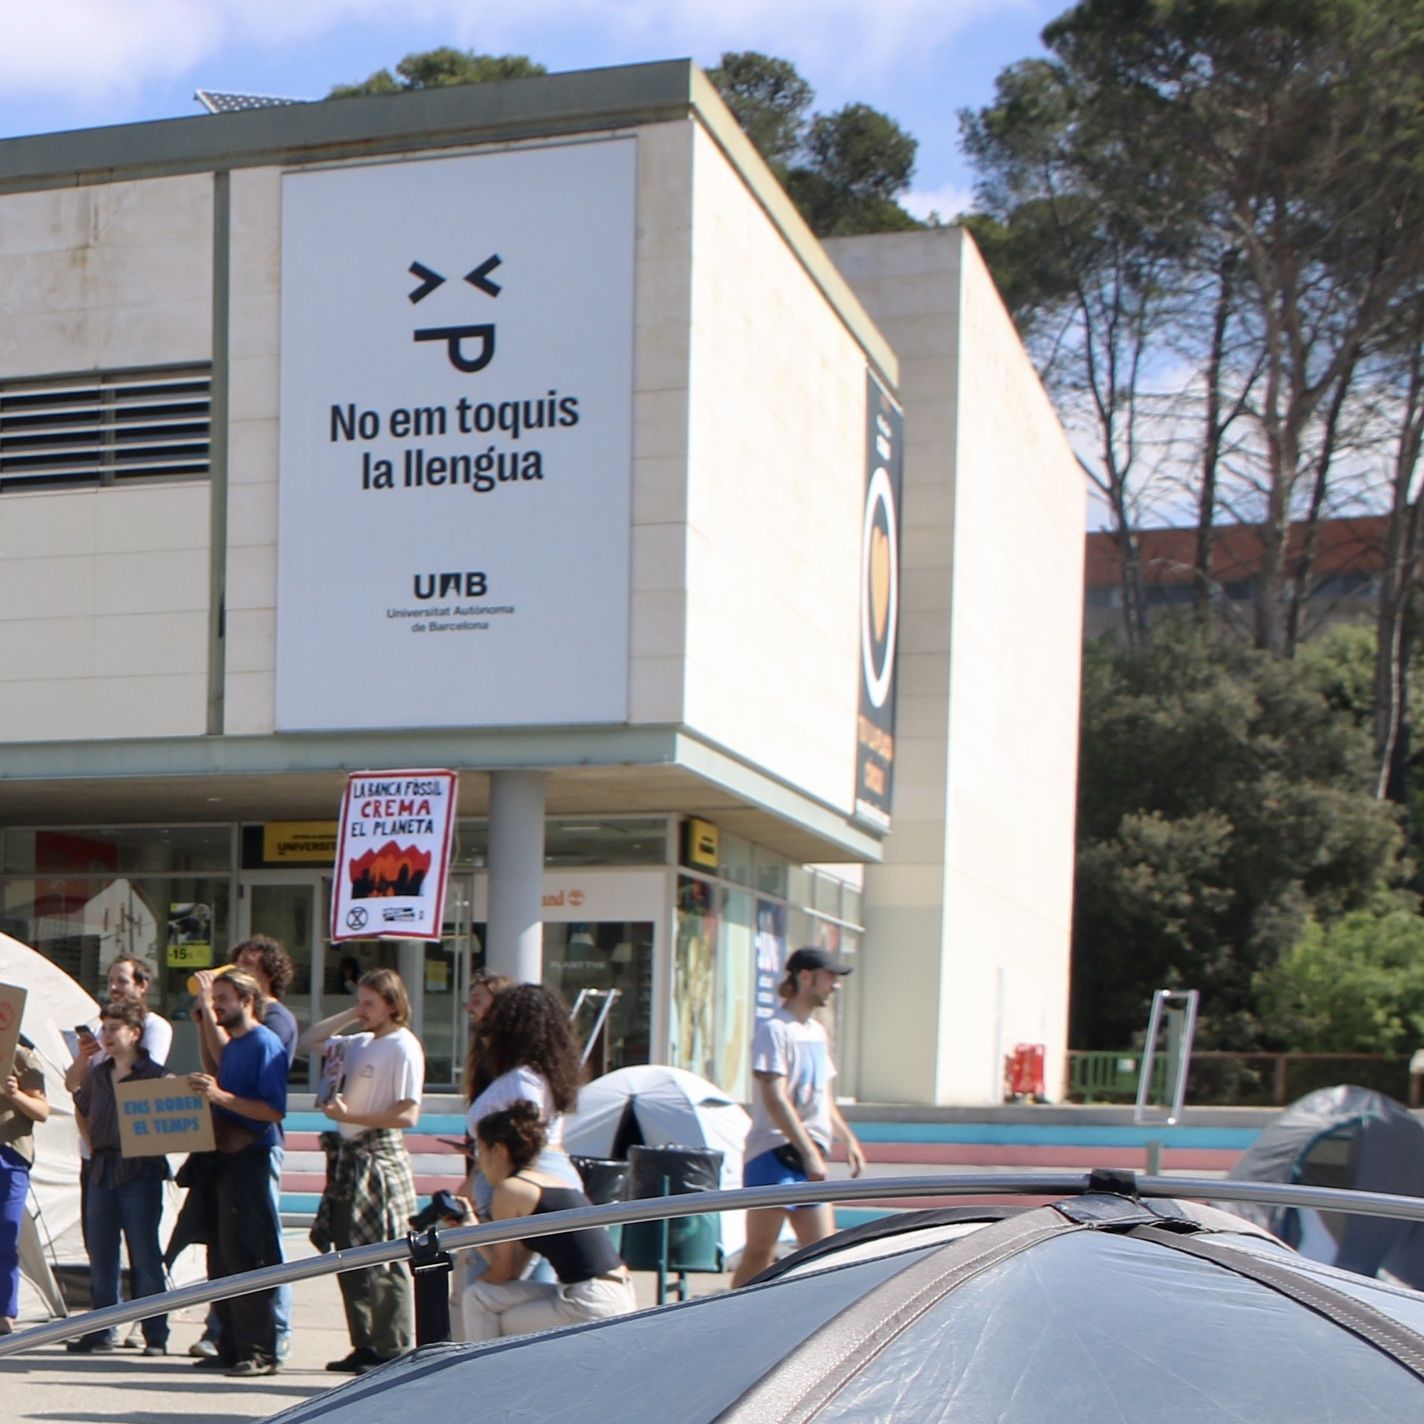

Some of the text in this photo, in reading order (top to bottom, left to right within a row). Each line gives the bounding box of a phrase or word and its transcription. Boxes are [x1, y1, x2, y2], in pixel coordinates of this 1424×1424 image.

[330, 389, 579, 442] No em toquis
[362, 445, 544, 493] la llengua
[413, 571, 488, 600] UAB
[386, 604, 515, 619] Universitat Autònoma
[411, 620, 489, 633] de Barcelona
[354, 782, 367, 798] LA
[367, 780, 402, 798] BANCA
[360, 799, 431, 819] CREMA
[351, 818, 434, 838] EL PLANETA
[277, 842, 336, 852] UNIVERSIT
[124, 1097, 204, 1116] ENS ROBEN
[132, 1117, 201, 1136] EL TEMPS
